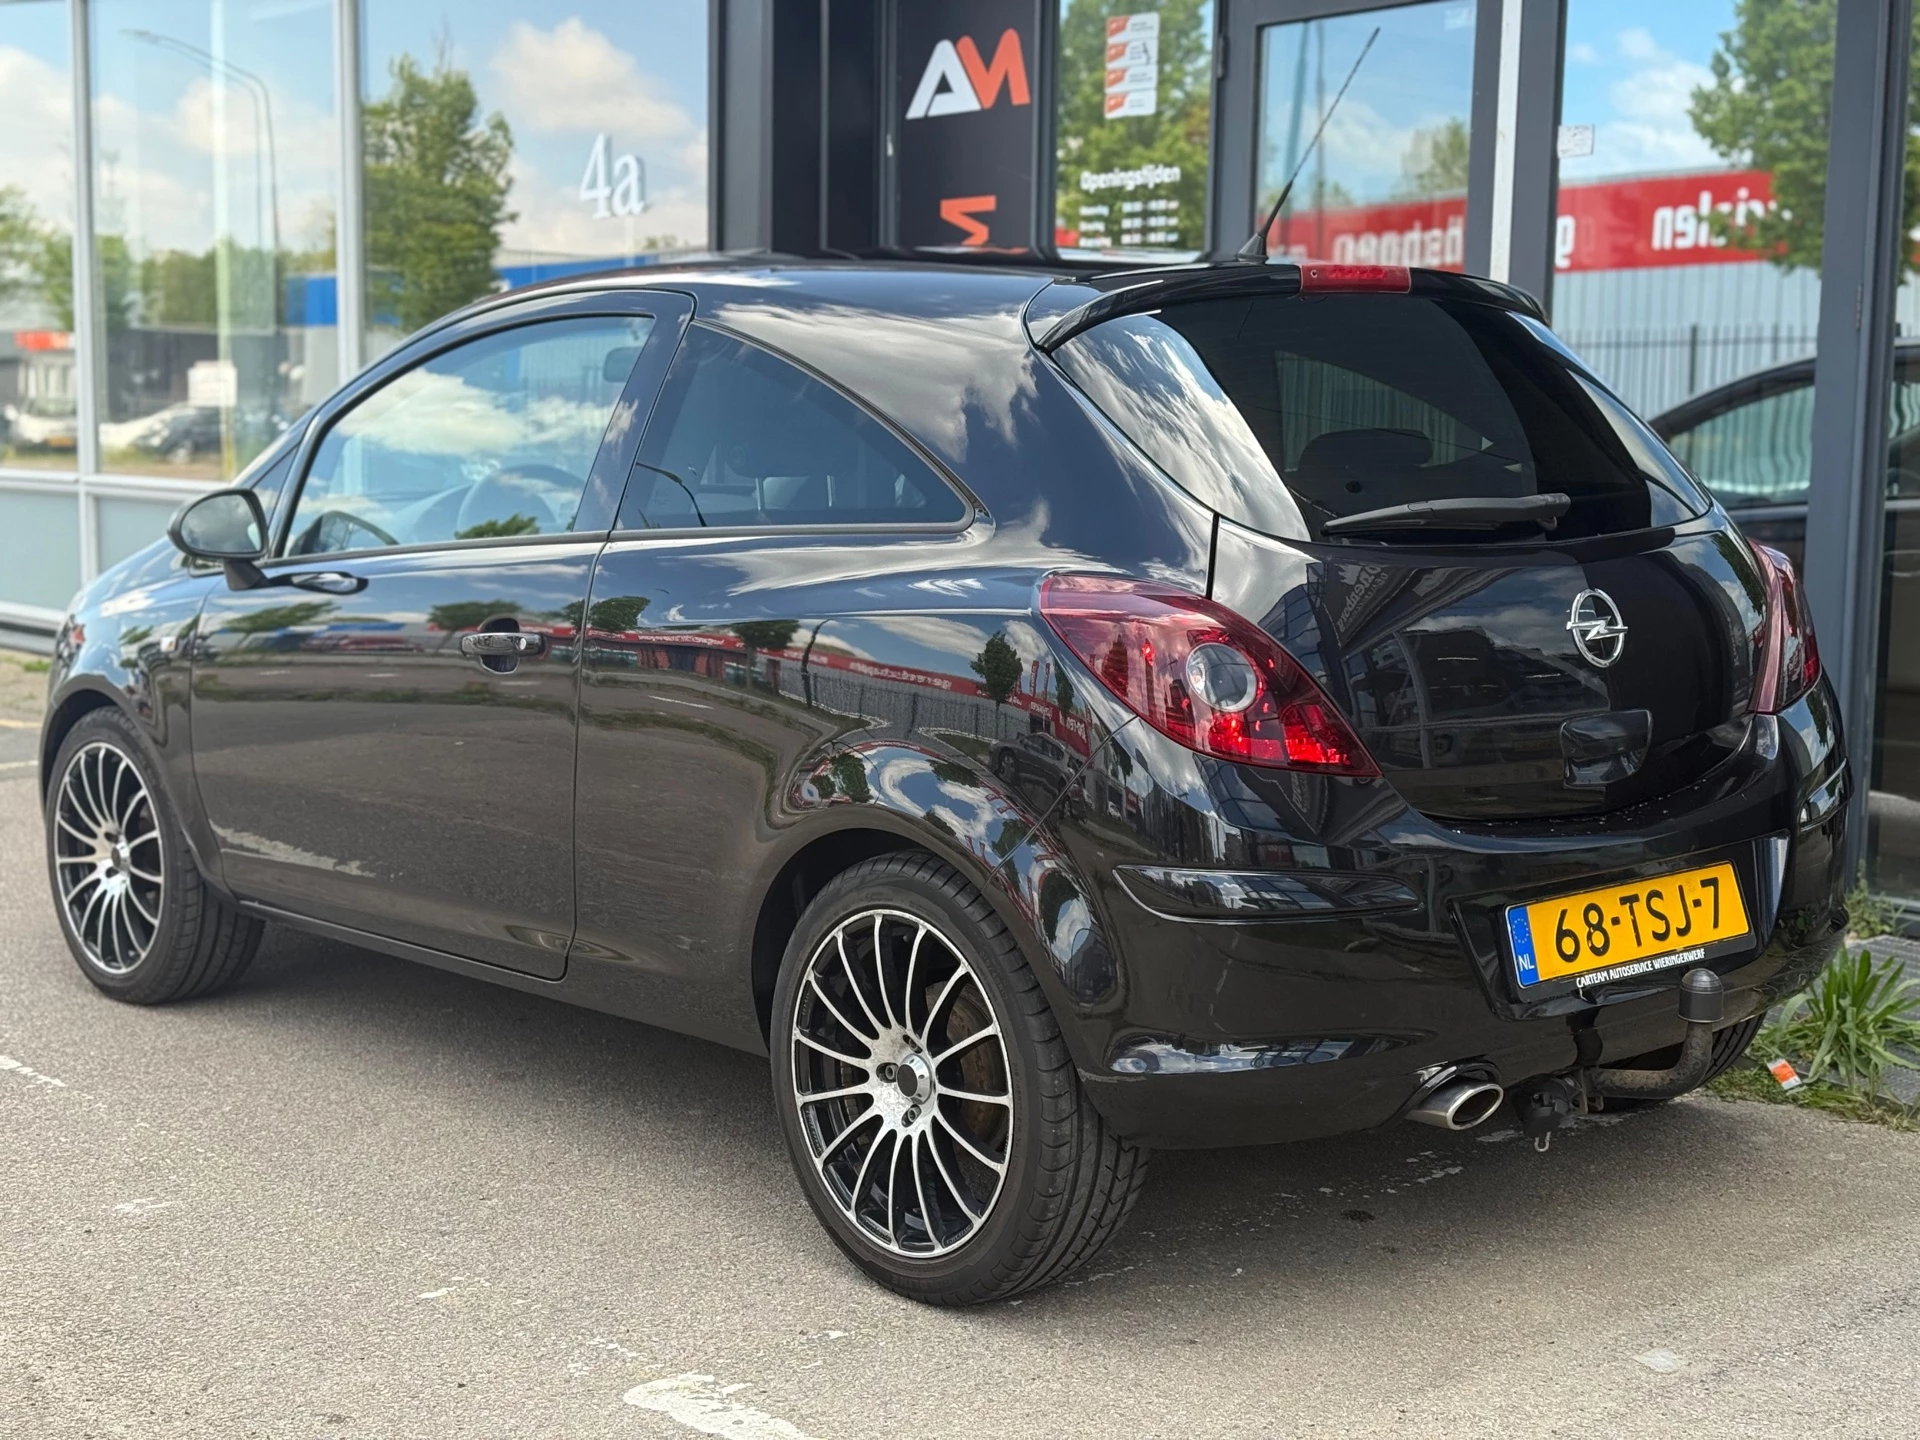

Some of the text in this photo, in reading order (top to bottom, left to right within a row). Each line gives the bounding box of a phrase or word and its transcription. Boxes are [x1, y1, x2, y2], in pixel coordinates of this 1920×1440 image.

[579, 132, 645, 217] 4a
[1555, 876, 1720, 963] 68-TSJ-7
[1517, 955, 1535, 972] NL
[1576, 948, 1706, 988] CARTEAM AUTOSERVICE WIERINGERWERF
